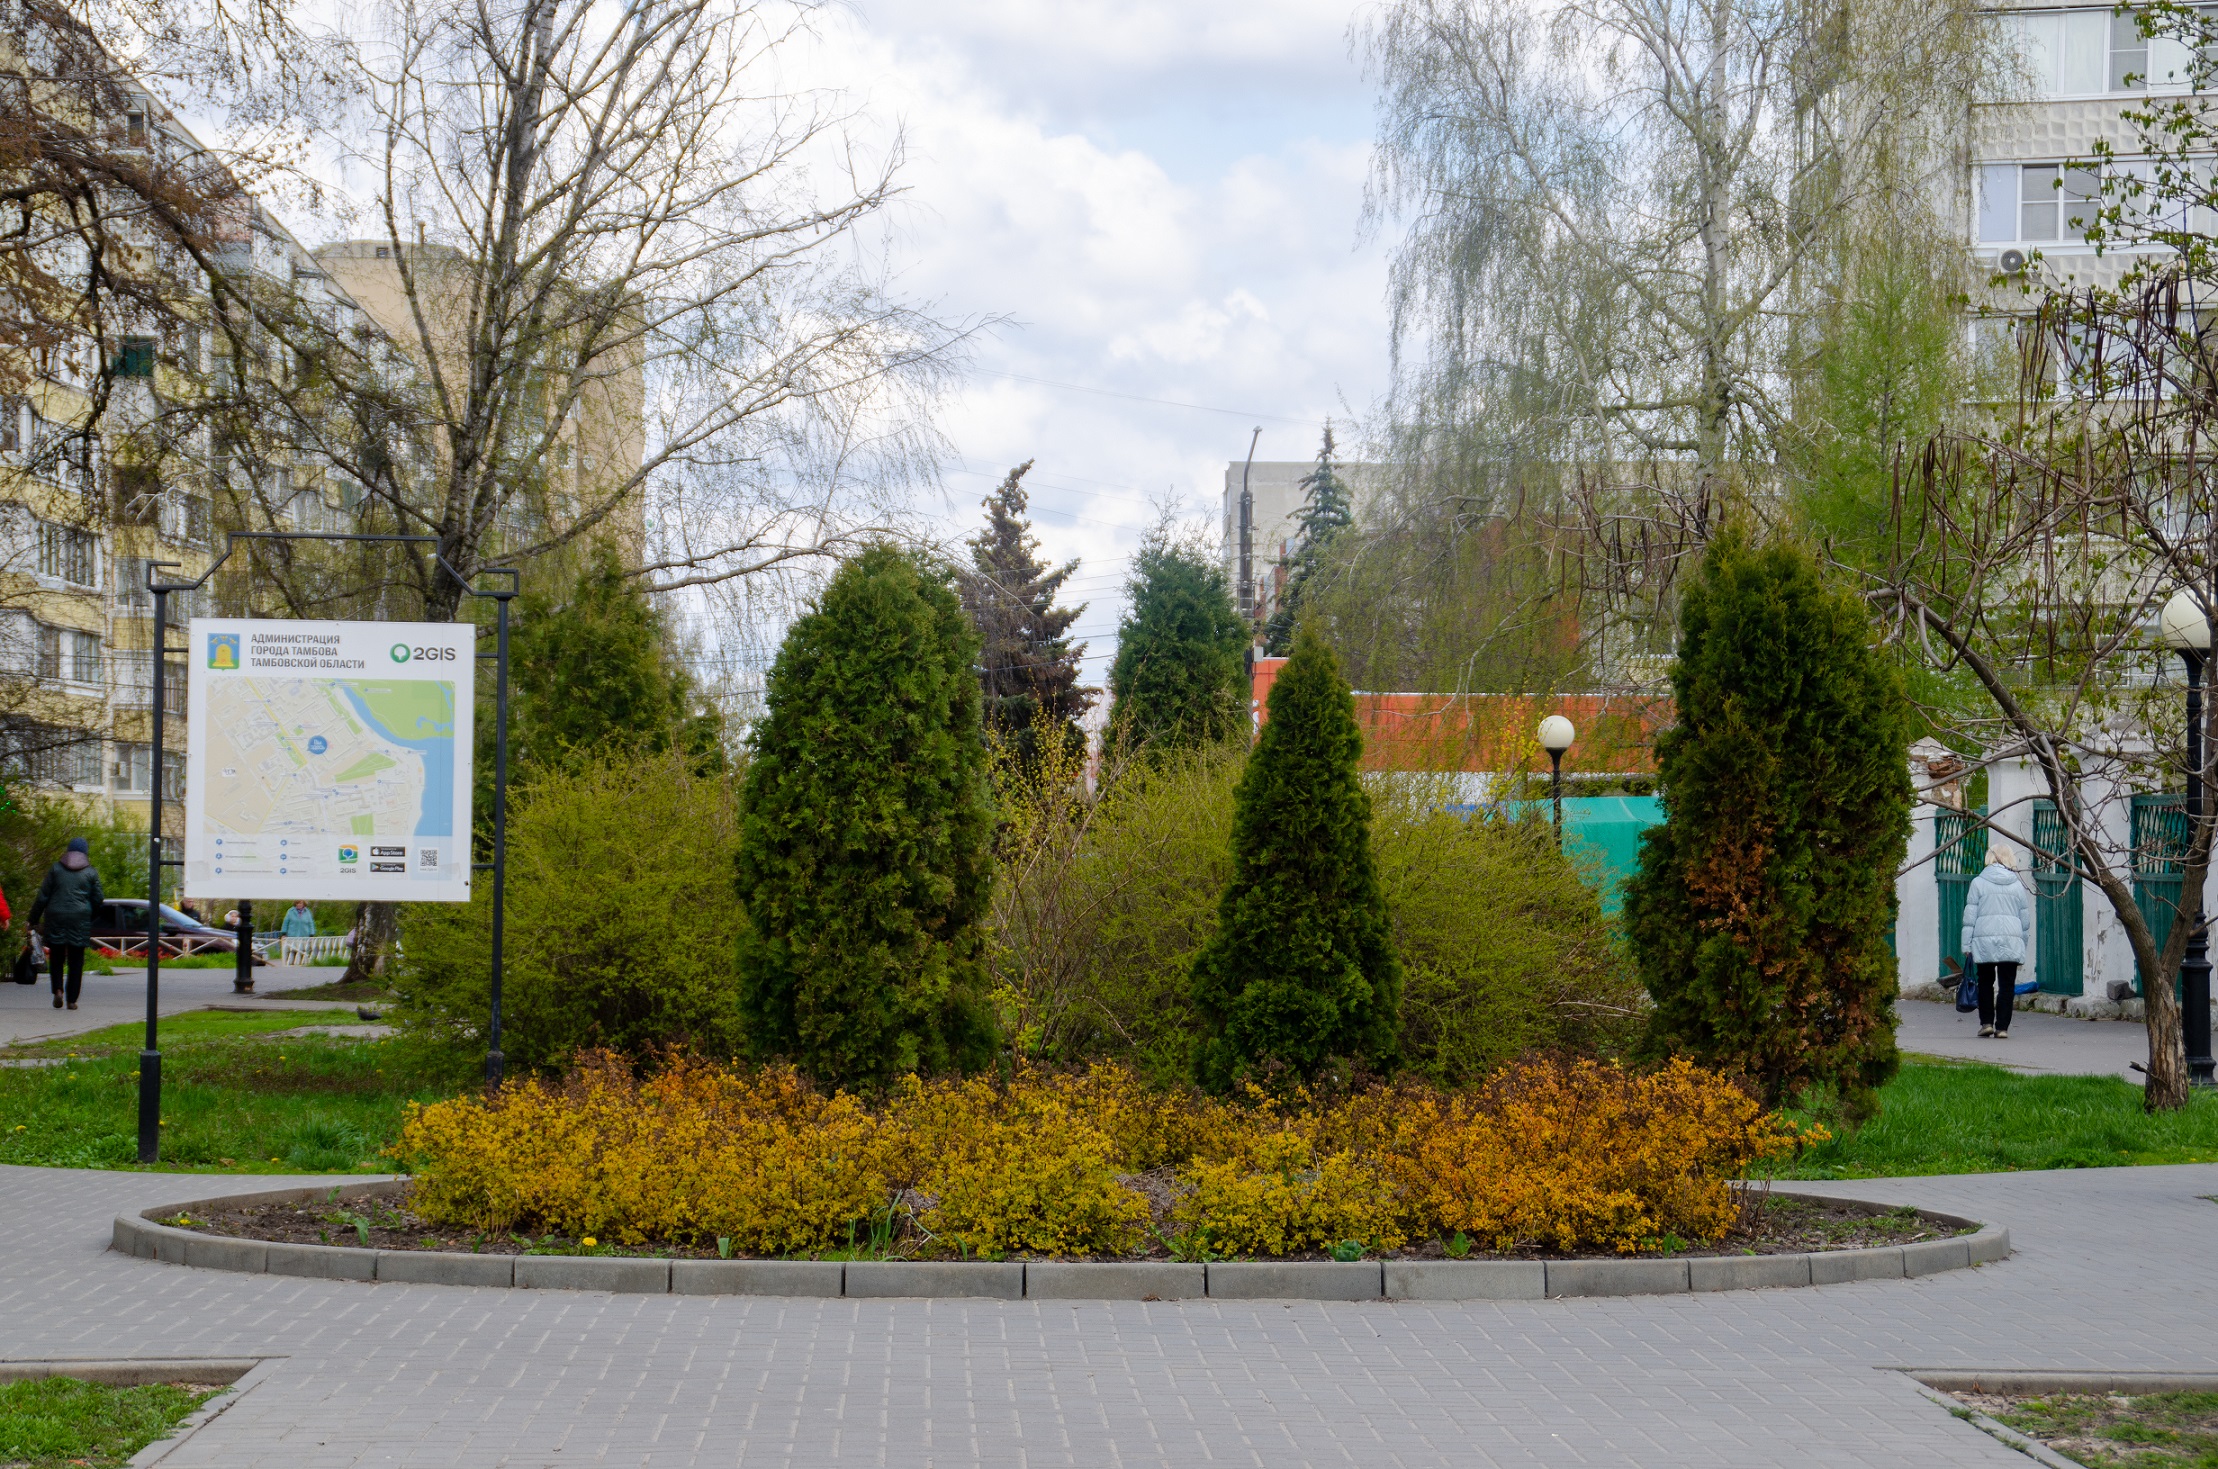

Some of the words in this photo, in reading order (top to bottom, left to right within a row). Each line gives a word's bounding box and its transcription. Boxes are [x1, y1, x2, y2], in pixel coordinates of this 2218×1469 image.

[251, 633, 340, 645] АДМИНИСТРАЦИЯ
[251, 646, 289, 657] ГОРОДА
[292, 646, 338, 656] ТАМБОВА
[413, 647, 456, 661] 2GIS
[251, 657, 317, 667] ТАМБОВСКОЙ
[320, 659, 365, 669] ОБЛАСТИ
